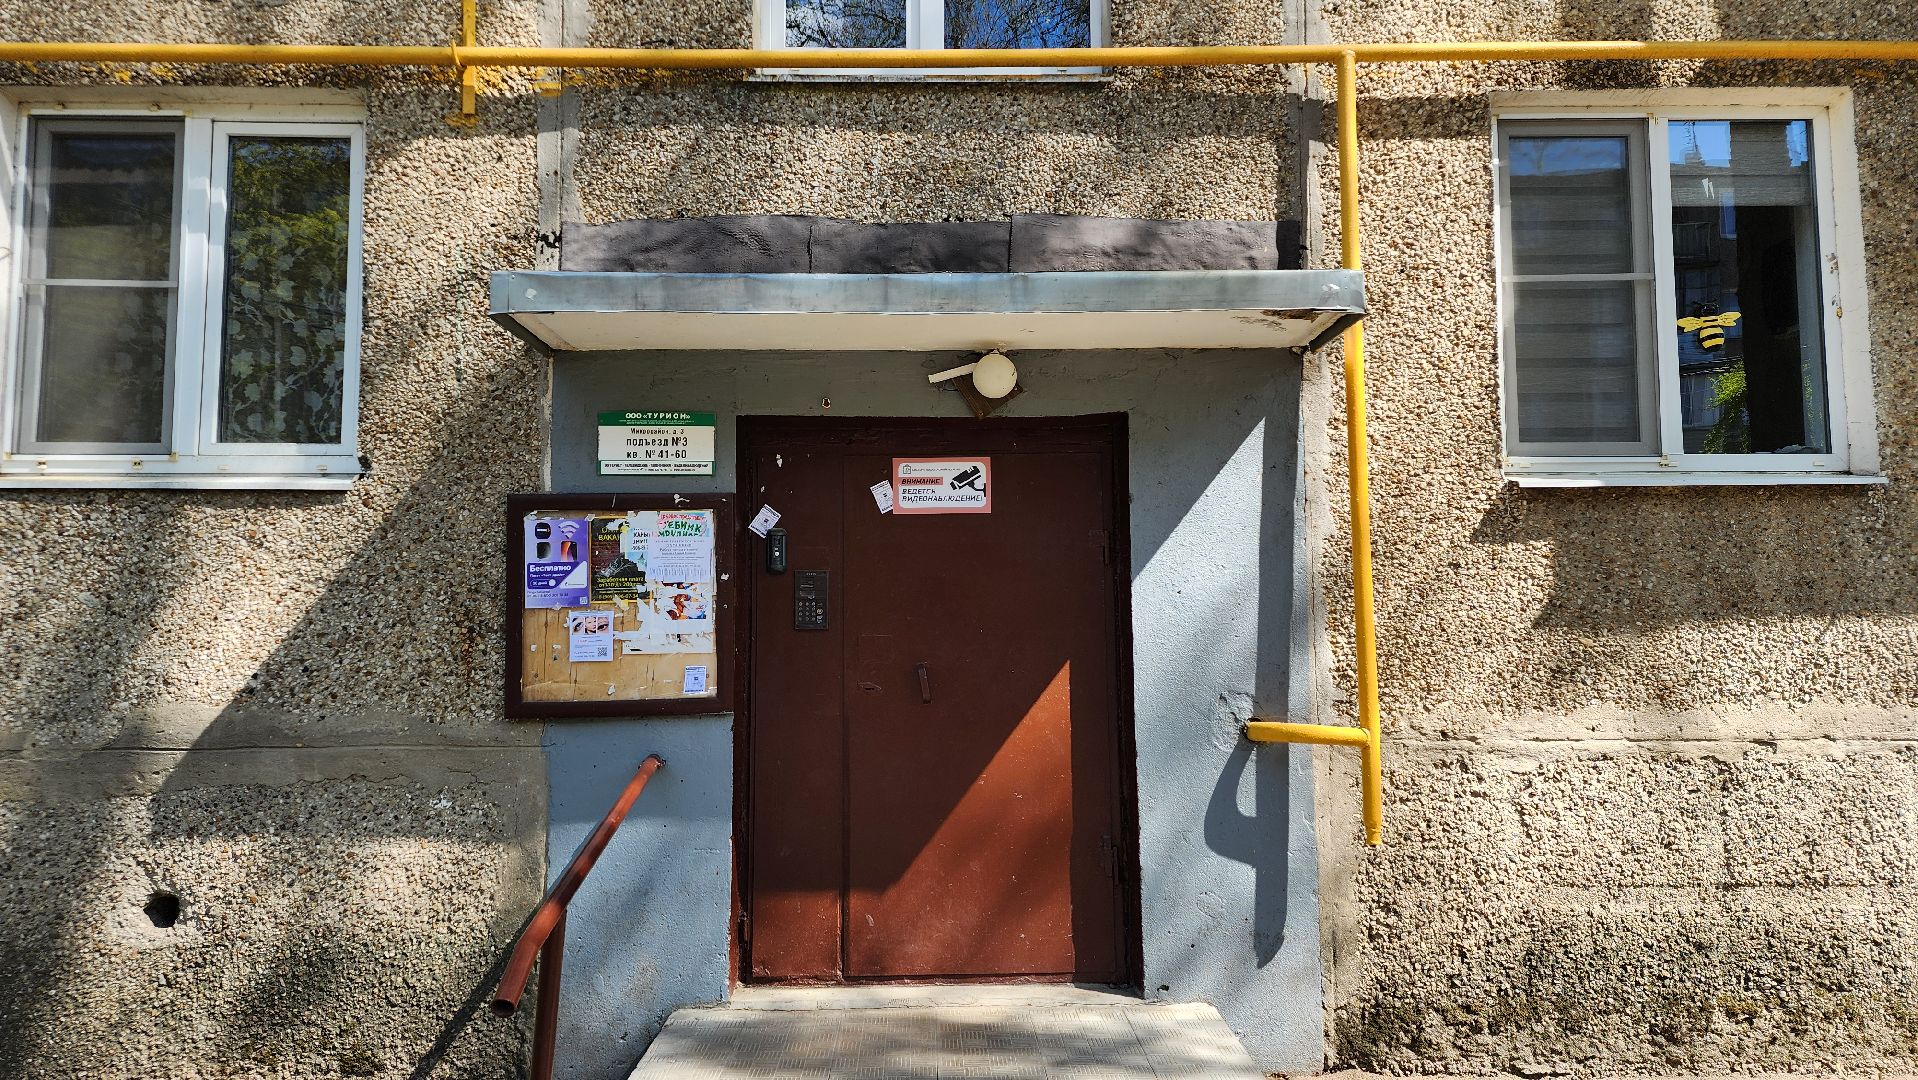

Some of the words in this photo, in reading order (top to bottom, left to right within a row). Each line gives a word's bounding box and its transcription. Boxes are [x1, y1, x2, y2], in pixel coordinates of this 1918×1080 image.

[626, 438, 669, 447] подъезд
[626, 451, 642, 459] кв.
[901, 495, 983, 503] ВИДЕОНАБЛЮДЕНИЕ!
[529, 564, 572, 573] Бесплатно
